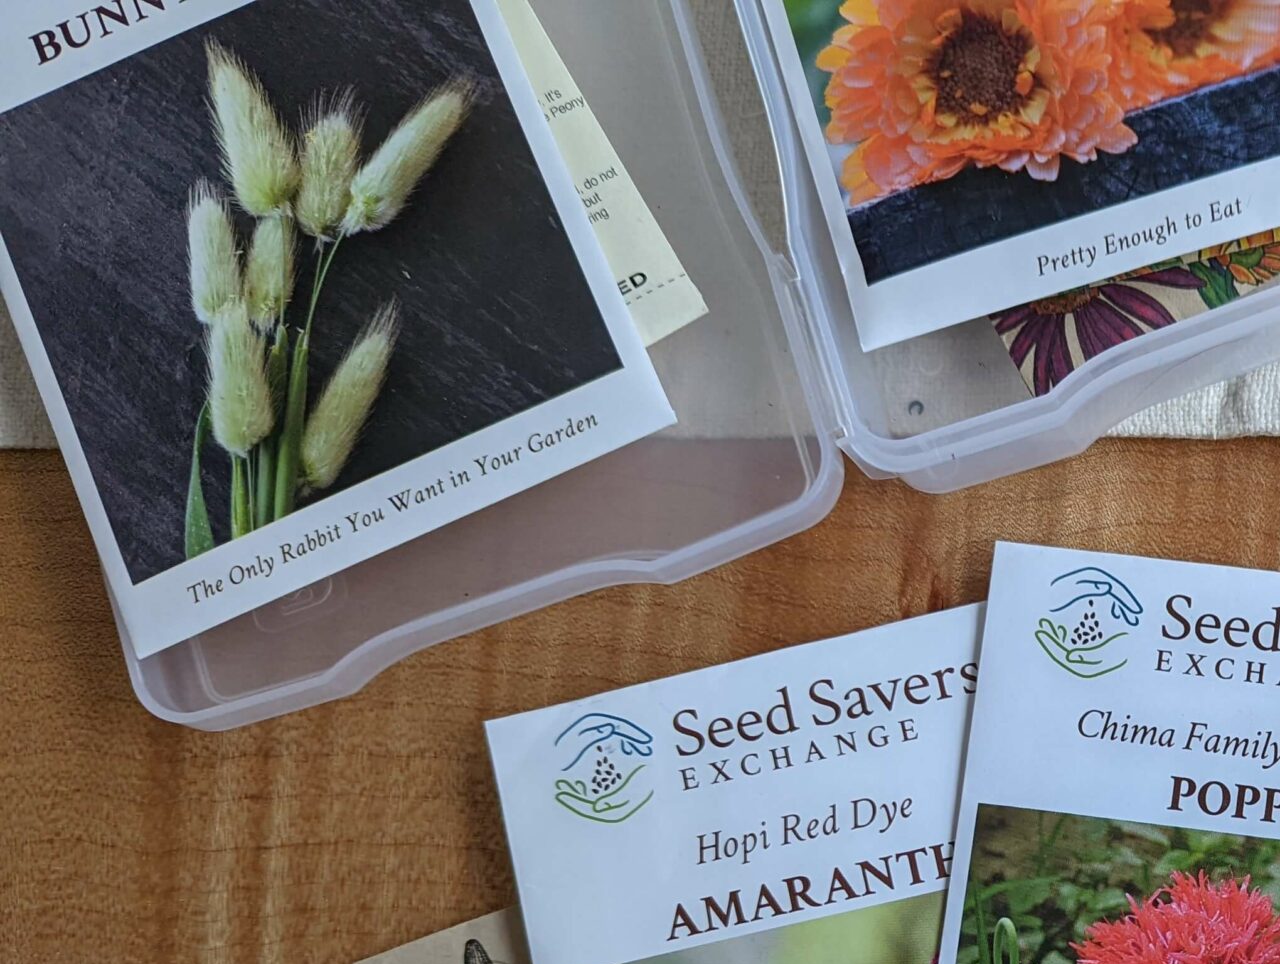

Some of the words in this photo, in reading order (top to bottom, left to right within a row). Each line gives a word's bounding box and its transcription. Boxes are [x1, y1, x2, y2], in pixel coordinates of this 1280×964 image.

[544, 89, 562, 103] It's
[550, 96, 584, 118] Peony
[584, 177, 599, 190] do
[599, 167, 618, 182] not
[1037, 246, 1097, 276] Pretty
[1104, 216, 1177, 256] Enough
[1185, 214, 1202, 230] to
[1208, 197, 1242, 223] Eat
[187, 577, 224, 604] The
[229, 556, 275, 585] Only
[280, 525, 342, 563] Rabbit
[345, 507, 385, 534] You
[387, 478, 445, 513] Want
[450, 470, 472, 489] in
[473, 447, 522, 478] Your
[527, 413, 600, 453] Garden
[672, 687, 800, 757] Seed
[809, 662, 978, 727] Savers
[1077, 709, 1175, 749] Chima
[679, 719, 919, 791] EXCHANGE
[695, 829, 769, 865] Hopi
[780, 806, 839, 845] Red
[851, 795, 914, 837] Dye
